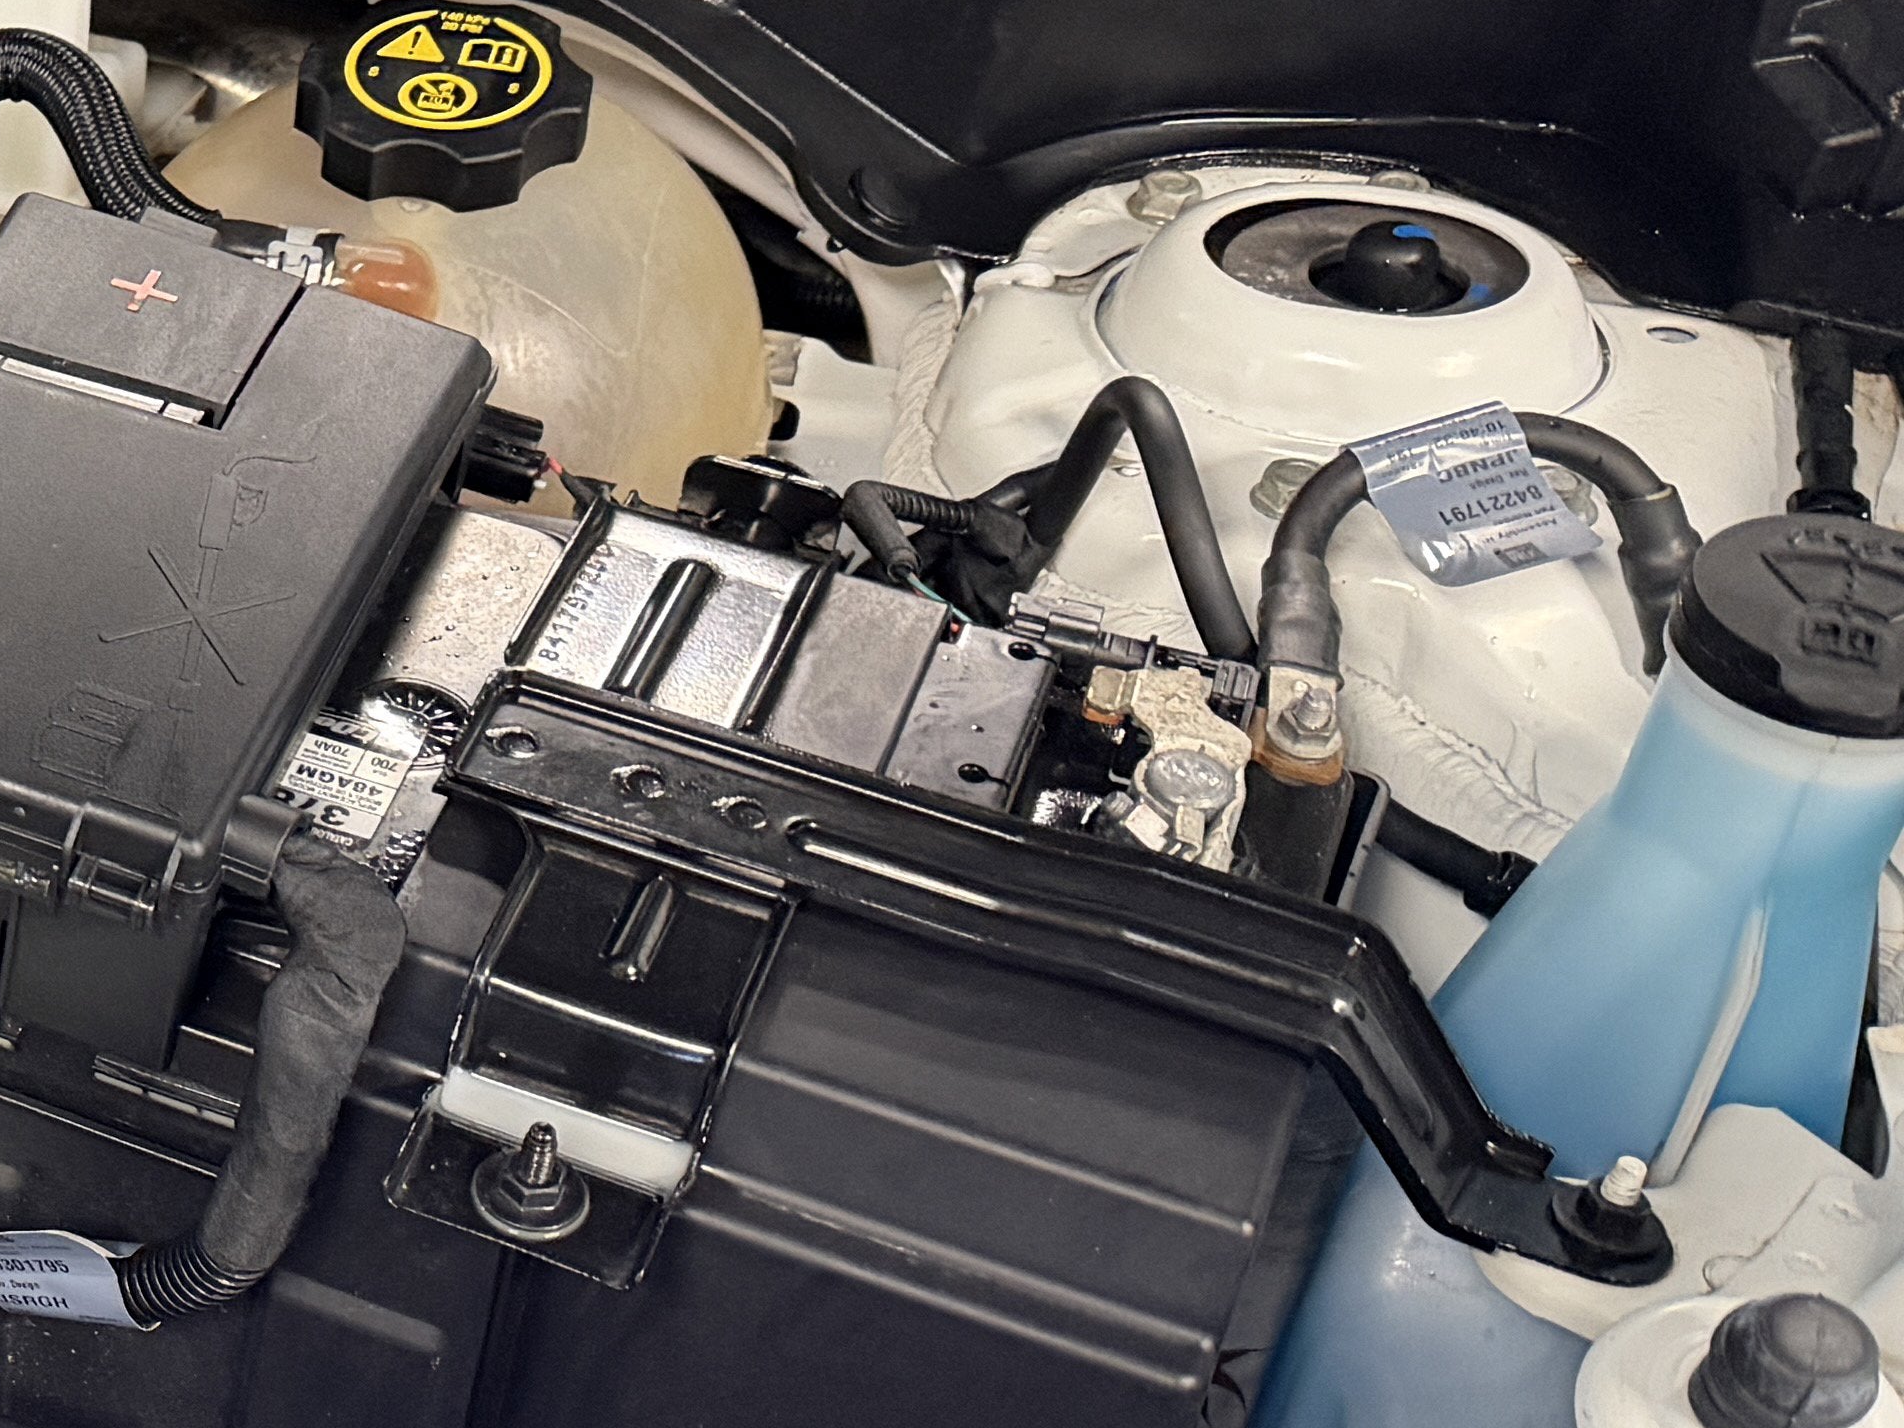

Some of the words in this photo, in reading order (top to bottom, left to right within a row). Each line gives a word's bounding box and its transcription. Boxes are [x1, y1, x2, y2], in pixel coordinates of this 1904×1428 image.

[1438, 484, 1544, 527] 84221791
[296, 763, 384, 798] 48AGM
[370, 756, 399, 772] 700
